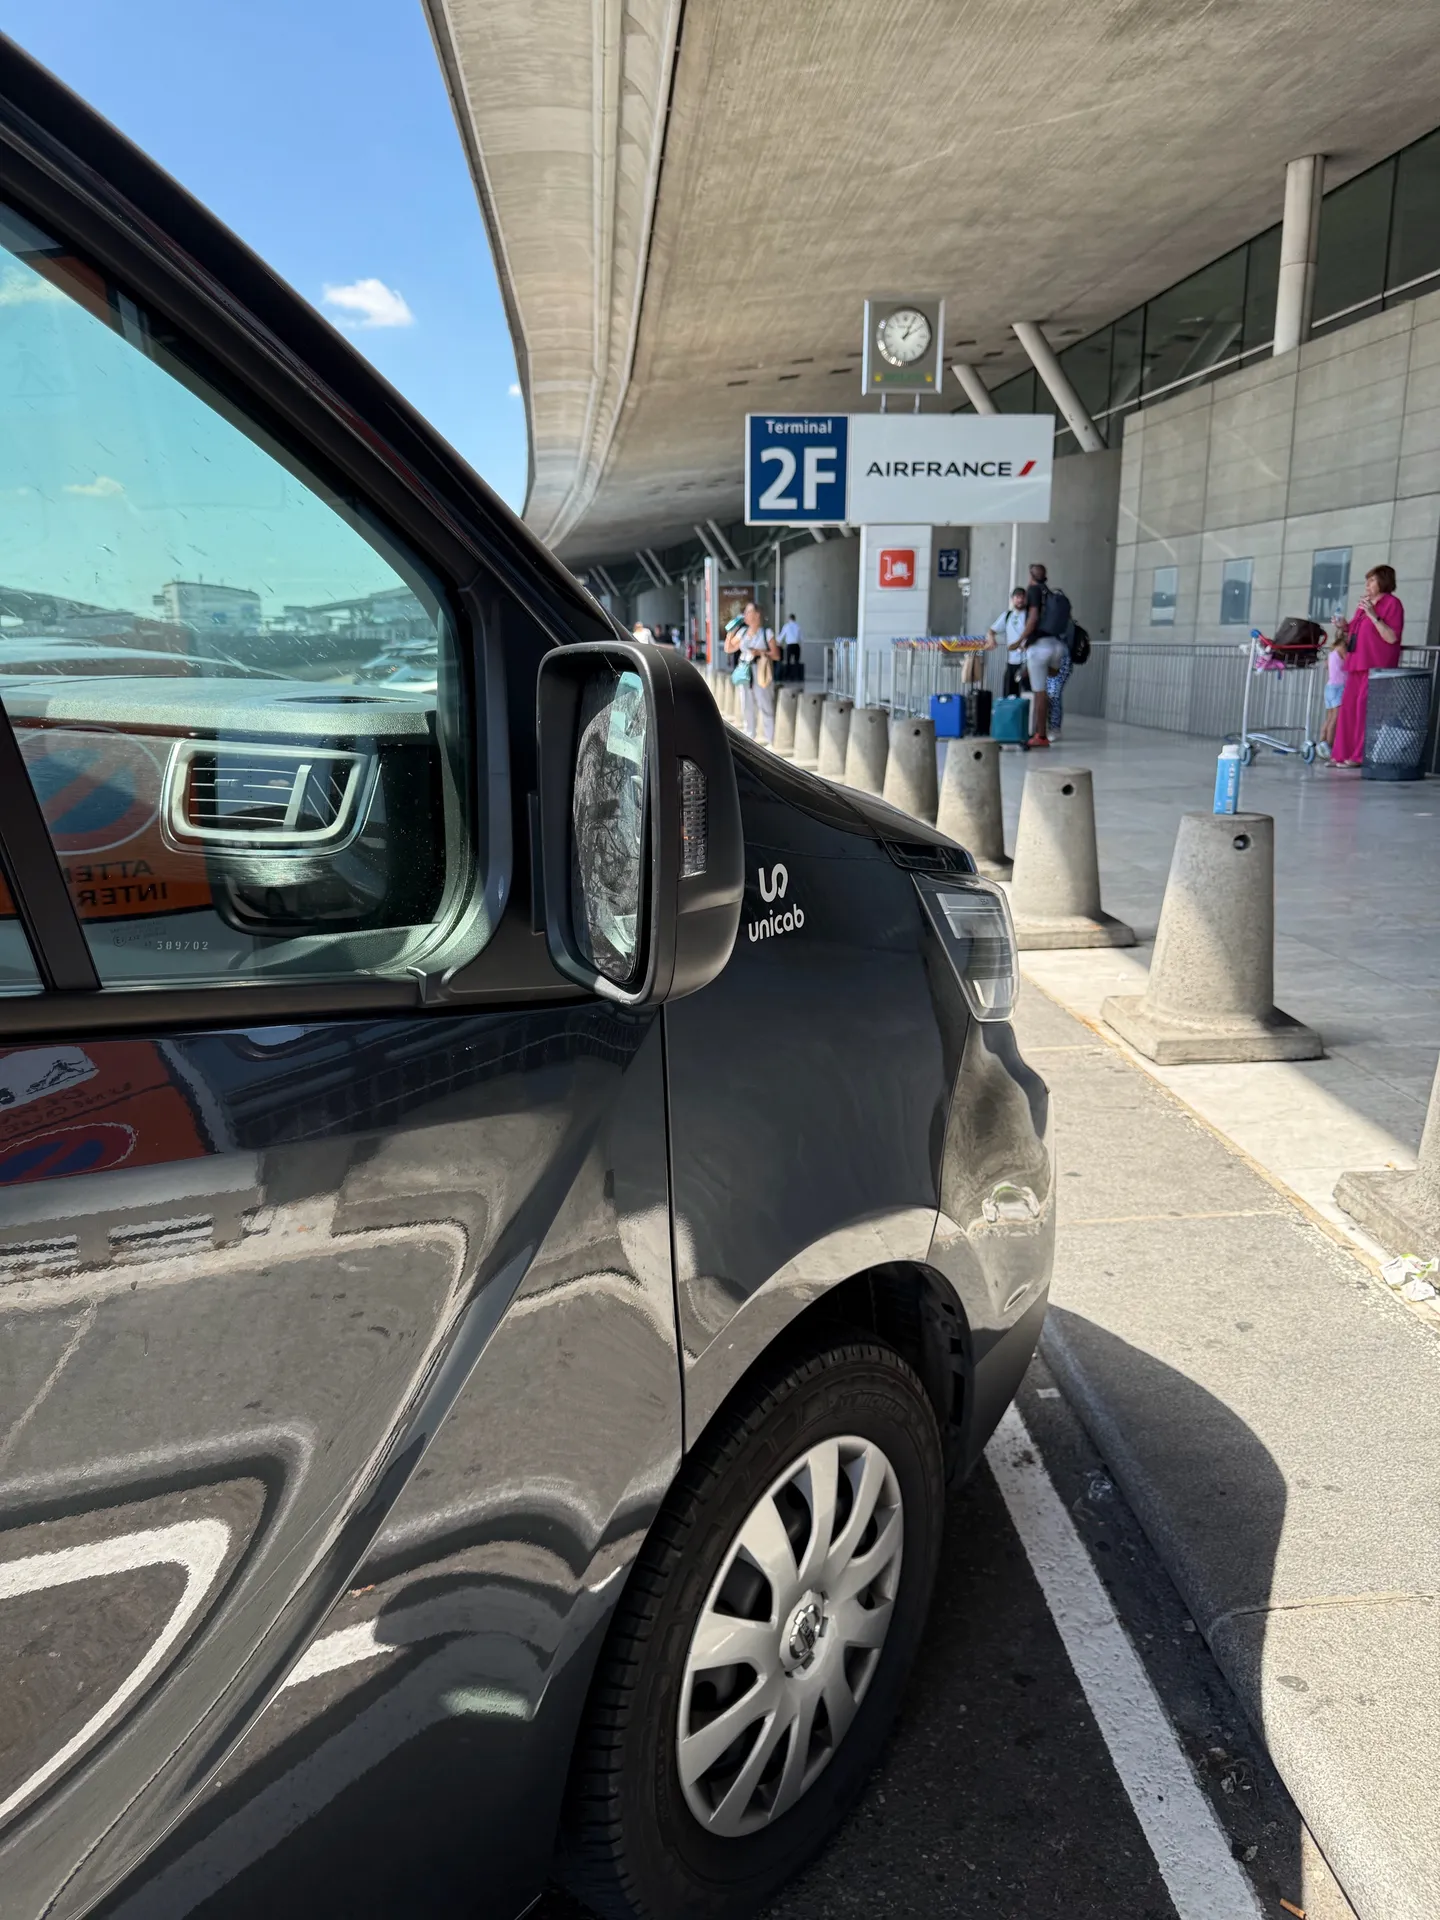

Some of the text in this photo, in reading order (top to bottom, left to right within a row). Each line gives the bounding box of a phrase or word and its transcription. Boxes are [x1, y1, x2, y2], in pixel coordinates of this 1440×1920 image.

[766, 419, 832, 434] Terminal
[866, 461, 1012, 477] AIRFRANCE
[759, 446, 837, 510] 2F
[940, 556, 958, 571] 12
[748, 903, 805, 942] unicab
[157, 941, 209, 950] 389702
